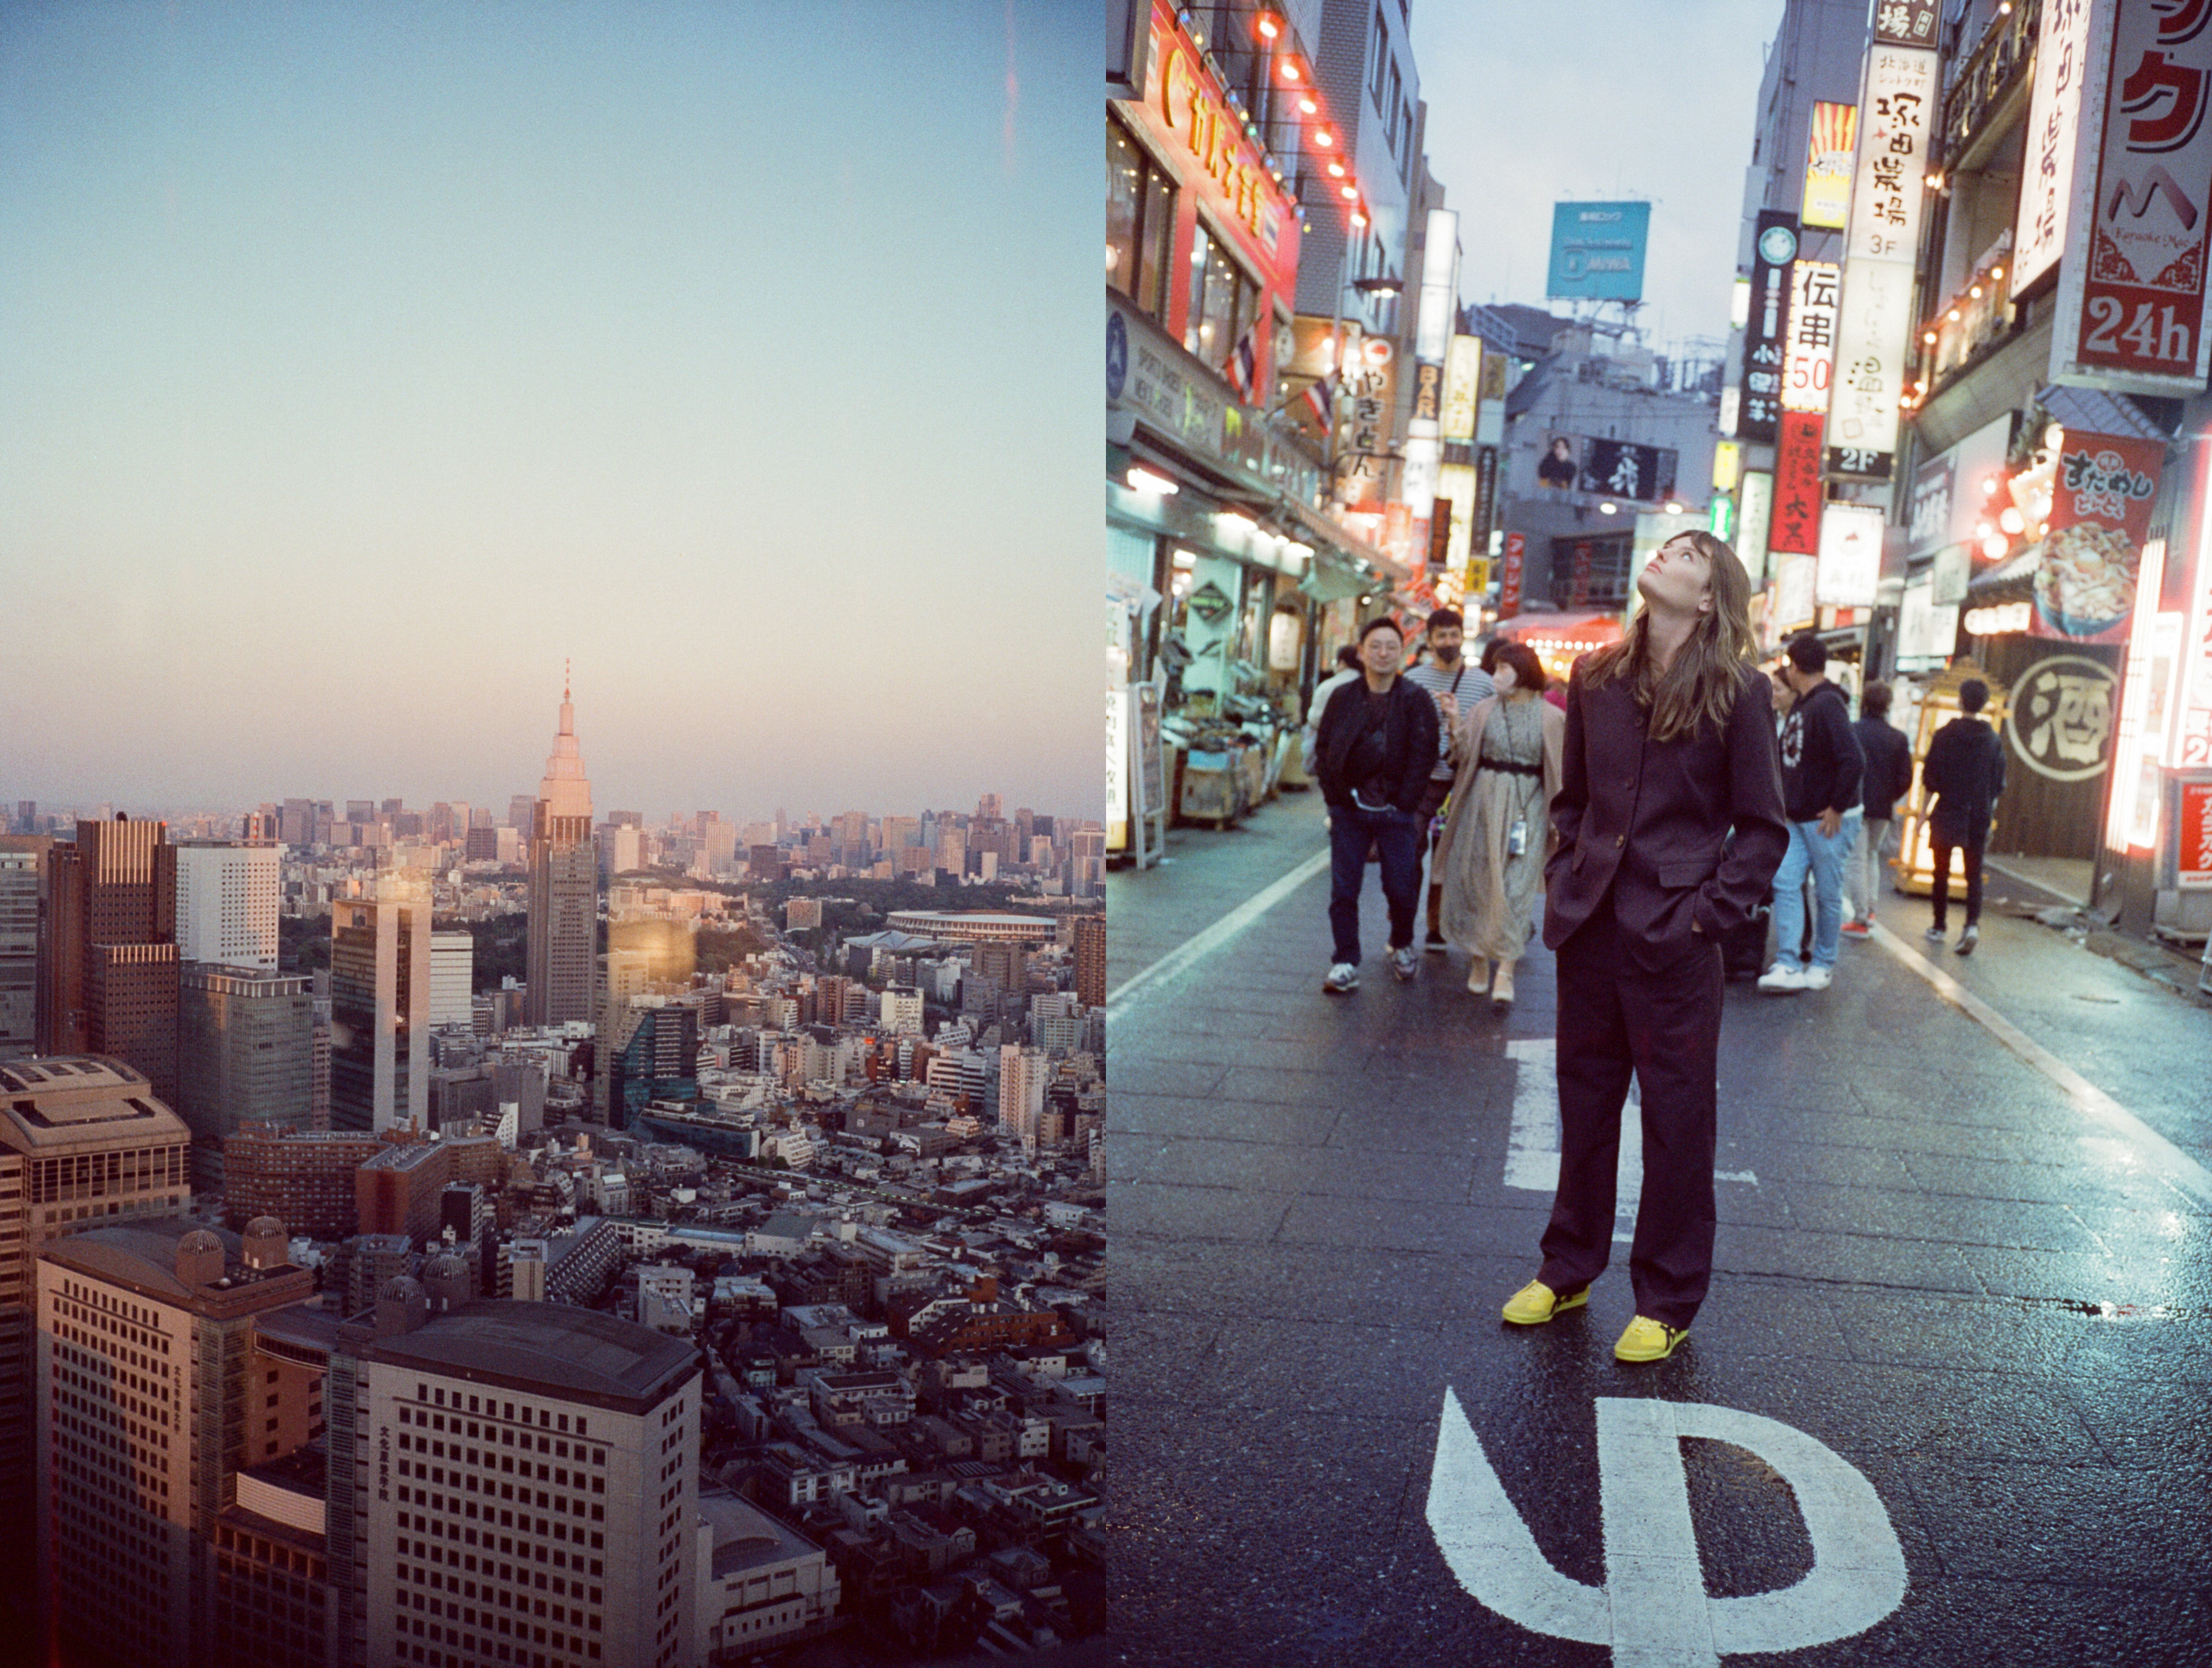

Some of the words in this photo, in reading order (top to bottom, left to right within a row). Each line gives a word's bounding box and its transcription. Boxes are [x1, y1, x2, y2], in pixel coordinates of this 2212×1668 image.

[1879, 54, 1927, 76] 北海道
[1870, 235, 1898, 255] 3F
[1799, 270, 1836, 349] 伝串
[2085, 295, 2190, 362] 24h
[1793, 357, 1830, 390] 50
[1841, 449, 1878, 471] 2F
